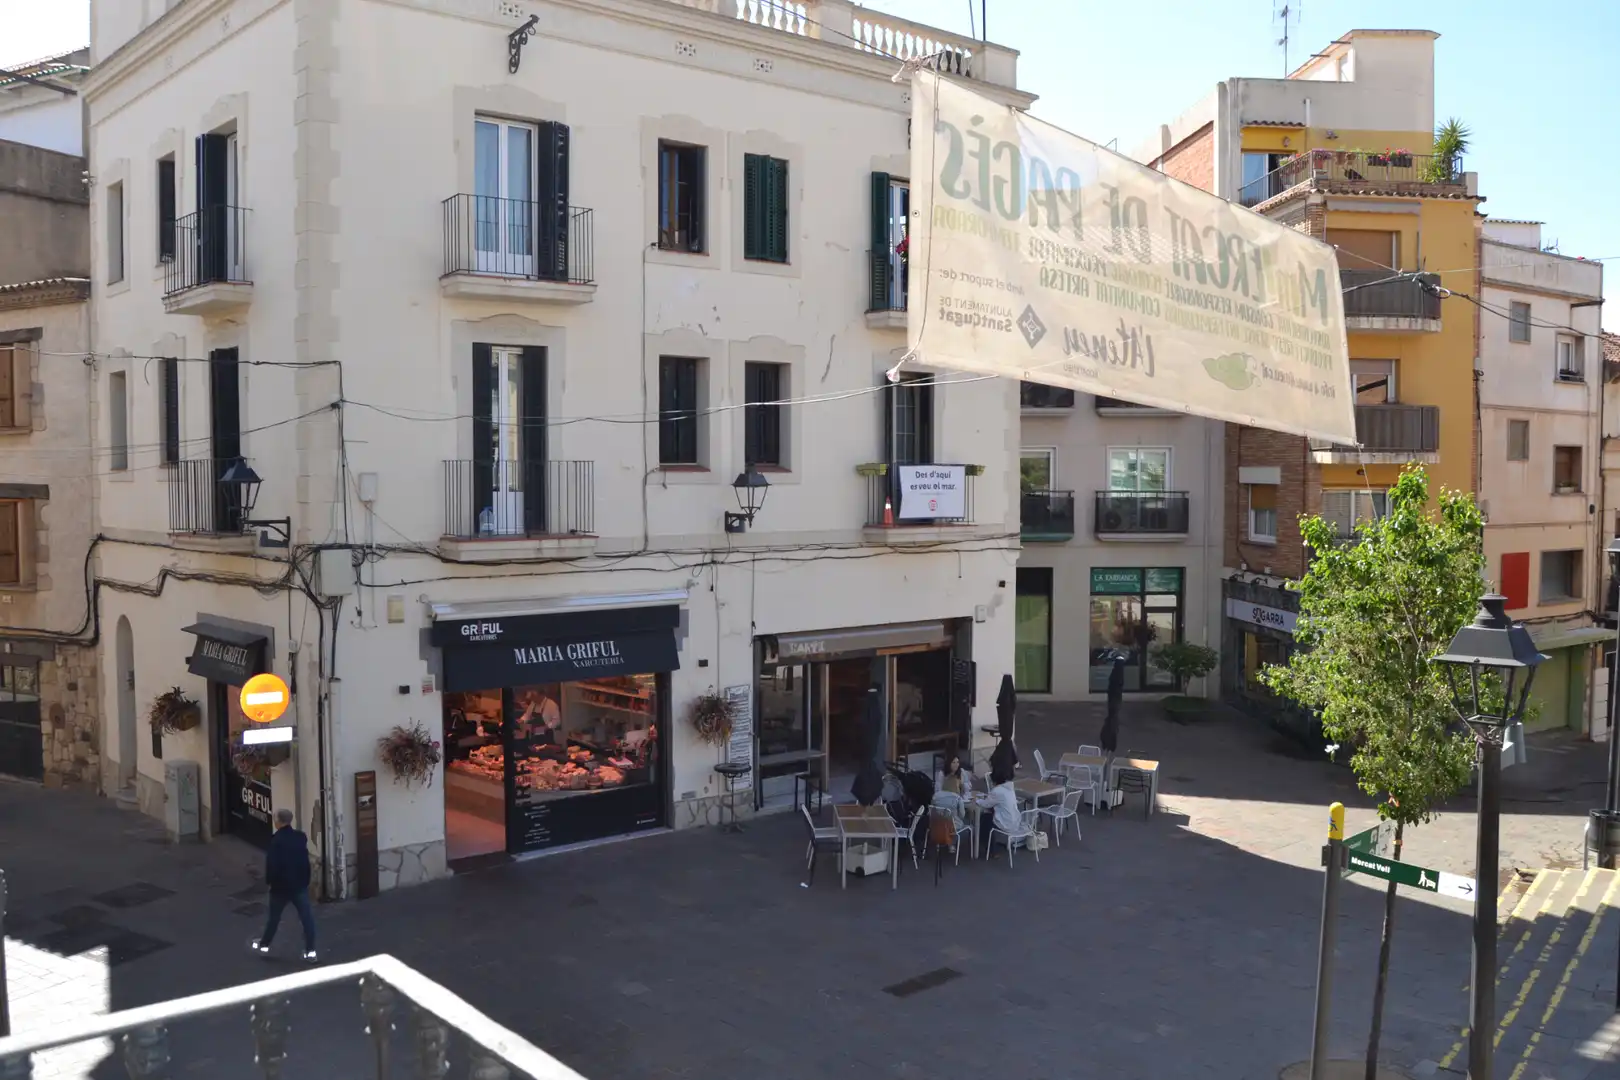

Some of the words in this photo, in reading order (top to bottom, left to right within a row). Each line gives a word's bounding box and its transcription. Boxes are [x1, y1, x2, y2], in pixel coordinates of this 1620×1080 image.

[915, 470, 928, 479] Des
[933, 481, 940, 490] el
[514, 645, 564, 665] MARIA
[566, 640, 620, 660] GRIFUL
[1351, 856, 1376, 869] Mercat
[1376, 863, 1391, 873] Vell
